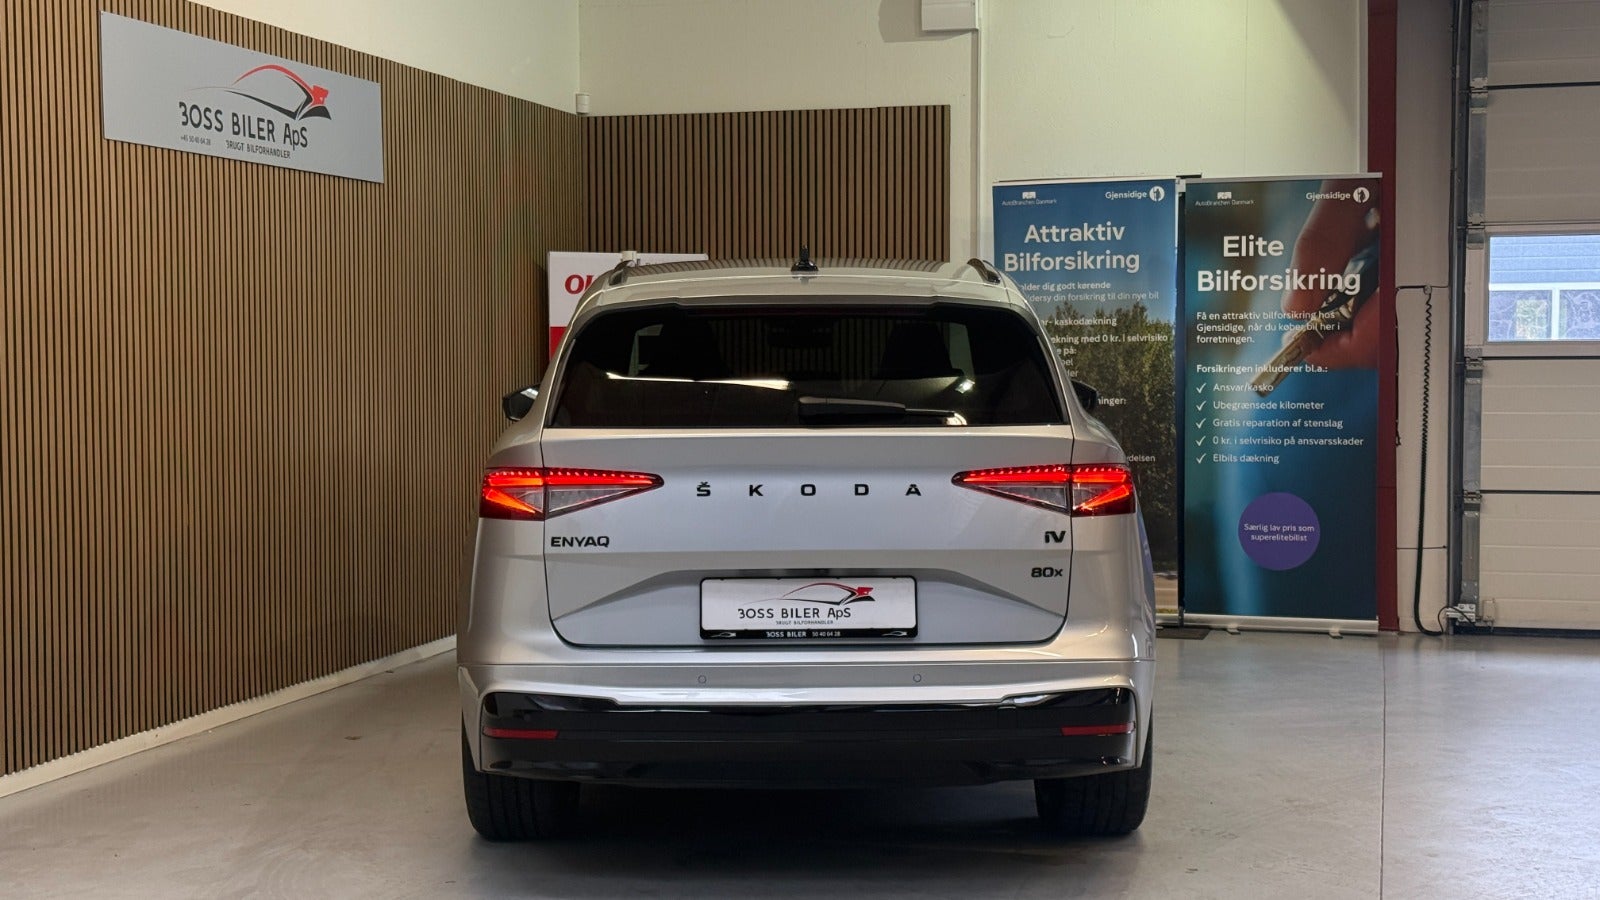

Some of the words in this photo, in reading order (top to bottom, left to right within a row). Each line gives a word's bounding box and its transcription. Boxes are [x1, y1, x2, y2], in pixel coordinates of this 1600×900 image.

[232, 112, 275, 142] BILER
[283, 123, 308, 150] ApS
[247, 143, 291, 159] BILFORHANDLER
[1105, 191, 1147, 200] Gjensidige
[1306, 192, 1350, 201] Gjensidige
[1024, 221, 1126, 244] Attraktiv
[1223, 234, 1285, 258] Elite
[1004, 249, 1140, 274] Bilforsikring
[1042, 282, 1055, 292] dig
[1057, 283, 1076, 292] godt
[1077, 281, 1111, 290] kørende
[1197, 267, 1361, 296] Bilforsikring
[1053, 294, 1066, 302] din
[1067, 292, 1106, 302] forsikring
[1107, 291, 1116, 300] til
[1117, 291, 1131, 300] din
[1132, 292, 1147, 301] nye
[1149, 290, 1159, 299] bil
[1055, 317, 1117, 326] kaskodækning
[1197, 311, 1207, 320] Få
[1222, 311, 1260, 320] attraktiv
[1262, 311, 1317, 321] bilforsikring
[1319, 311, 1335, 319] hos
[1197, 323, 1246, 333] Gjensidige,
[1248, 322, 1263, 331] når
[1265, 323, 1277, 331] du
[1320, 322, 1335, 331] her
[1081, 334, 1101, 343] med
[1102, 334, 1108, 343] 0
[1110, 334, 1121, 343] kr.
[1128, 333, 1168, 342] selvrisiko
[1196, 335, 1255, 344] forretningen.
[1063, 346, 1077, 356] på:
[1197, 364, 1253, 374] Forsikringen
[1255, 364, 1302, 373] inkluderer
[1213, 382, 1274, 393] Ansvar/kasko
[1213, 401, 1278, 412] Ubegrænsede
[1279, 400, 1325, 410] kilometer
[1212, 418, 1241, 427] Gratis
[1242, 419, 1290, 429] reparation
[1292, 418, 1302, 427] af
[1303, 418, 1343, 429] stenslag
[1212, 436, 1219, 445] 0
[1239, 436, 1282, 445] selvrisiko
[1284, 436, 1296, 447] på
[1297, 437, 1364, 446] ansvarsskader
[1213, 453, 1238, 462] Elbils
[1239, 453, 1280, 464] dækning
[1244, 523, 1269, 532] Særlig
[1269, 524, 1281, 532] lav
[1282, 524, 1297, 533] pris
[551, 536, 610, 548] ENYAQ
[1250, 534, 1307, 542] superelitebilist
[781, 608, 820, 618] BILER
[827, 607, 851, 620] ApS
